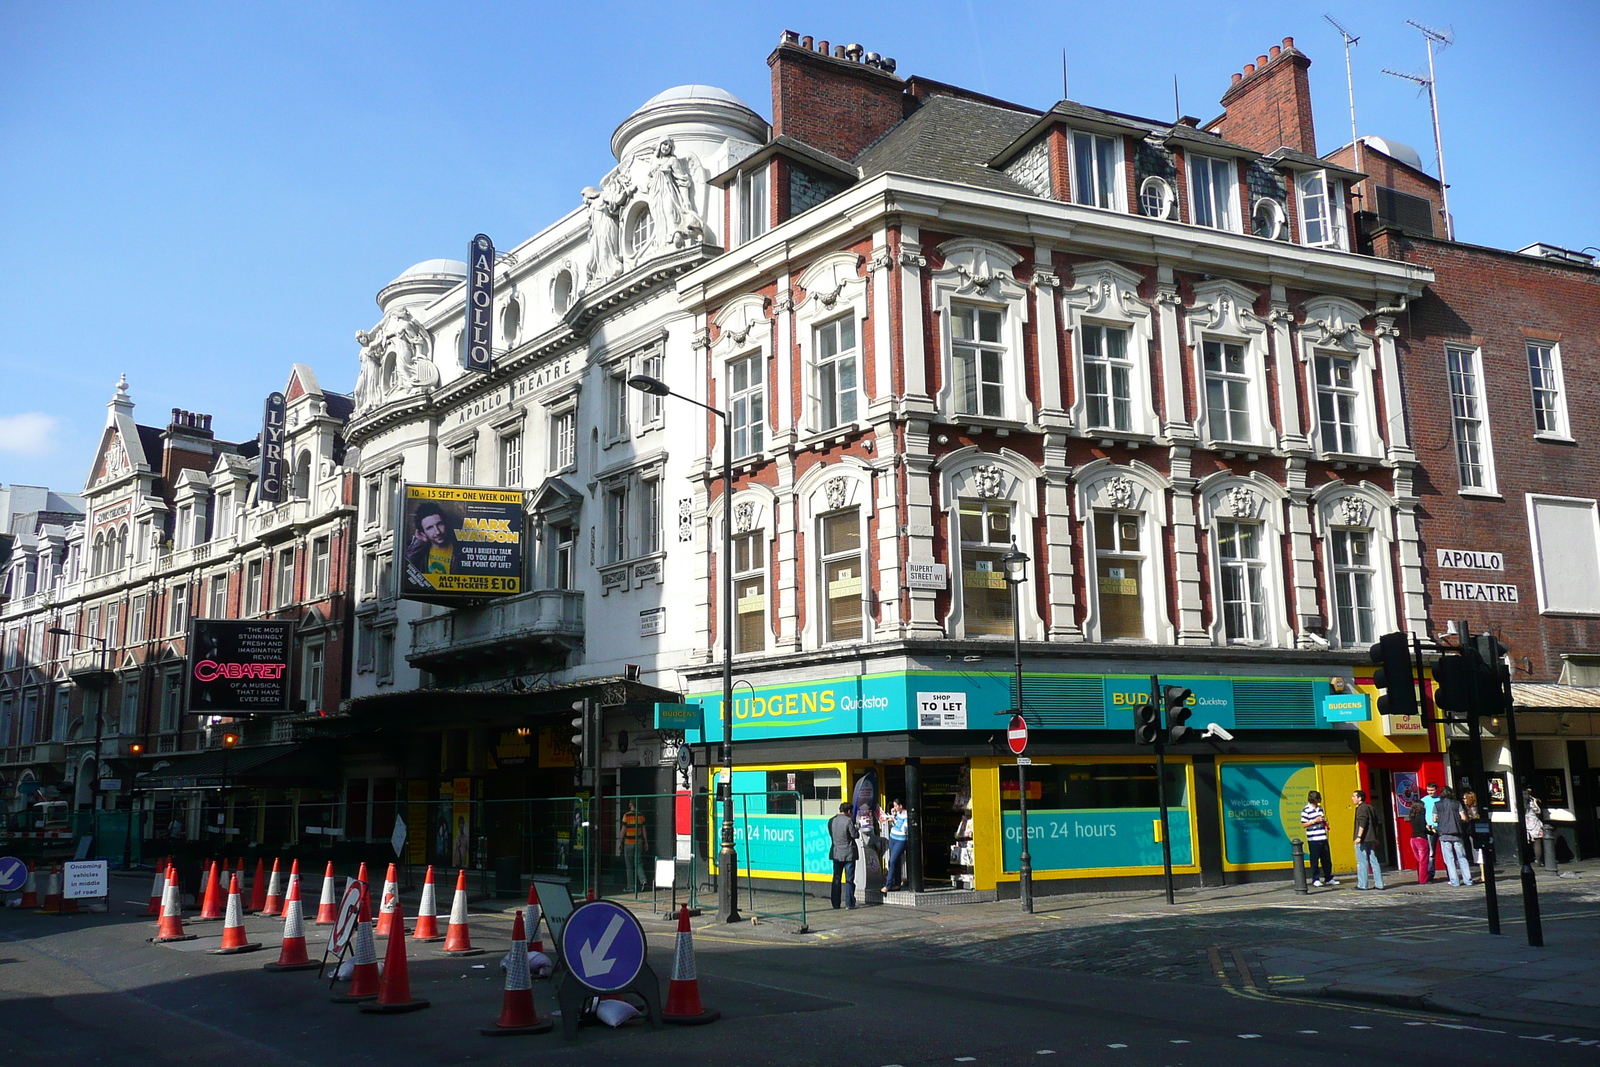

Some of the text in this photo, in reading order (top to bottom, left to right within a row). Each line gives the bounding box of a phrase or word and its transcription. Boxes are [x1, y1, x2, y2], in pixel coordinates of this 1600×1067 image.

[471, 254, 490, 363] APOLLO
[459, 394, 502, 424] APOLLO
[263, 410, 284, 493] LYRIC
[427, 490, 436, 498] 15
[438, 491, 454, 499] SEPT
[462, 492, 476, 500] ONE
[479, 493, 498, 501] WEEK
[500, 494, 520, 502] ONLY!
[462, 518, 511, 532] MARK
[454, 529, 519, 544] WATSON
[1442, 551, 1500, 570] APOLLO
[910, 564, 934, 572] RUPERT
[910, 572, 933, 580] STREET
[457, 582, 489, 590] TICKETS
[491, 578, 516, 590] £10
[964, 580, 1006, 588] ENGLISH
[1099, 586, 1137, 595] ENGLISH
[1443, 583, 1516, 601] THEATRE
[194, 660, 286, 682] CABARET
[840, 695, 889, 712] Quickstop
[1113, 692, 1228, 707] BUDS Quickstop
[1328, 702, 1362, 710] BUDGENS
[921, 702, 962, 711] TO LET
[662, 710, 697, 718] BUDGENS
[1230, 799, 1261, 807] Welcome
[1228, 809, 1273, 818] BUDGENS
[747, 825, 760, 839] 24
[763, 825, 794, 842] hours
[1050, 821, 1068, 838] 24
[1075, 820, 1117, 837] hours
